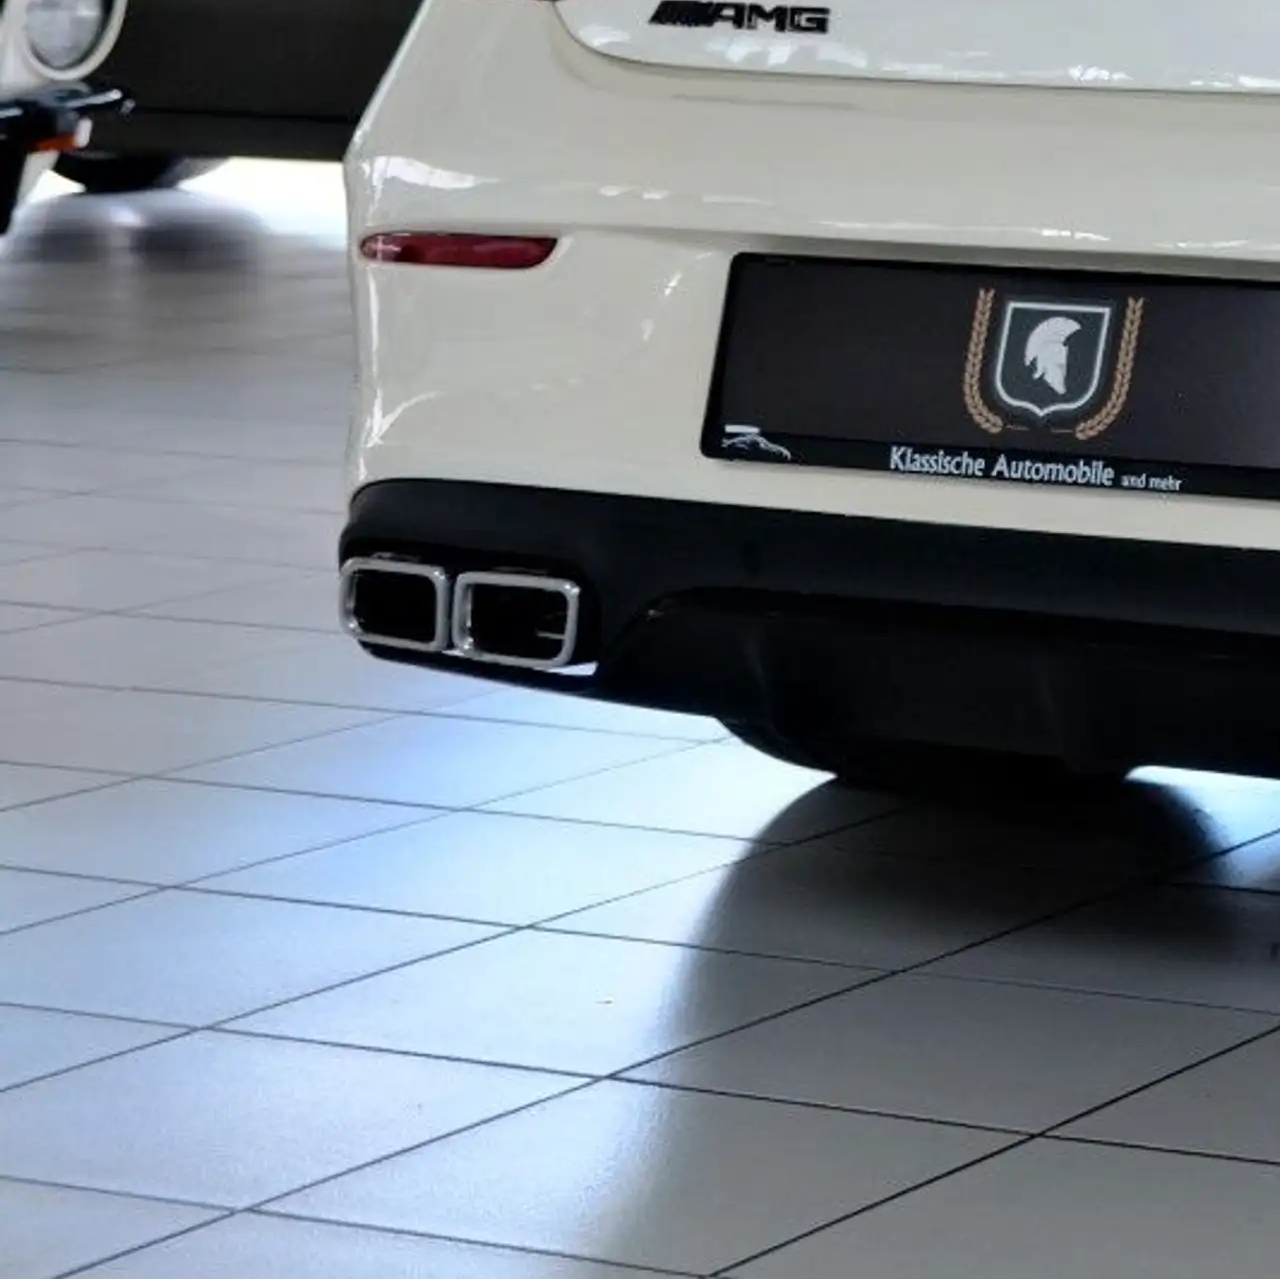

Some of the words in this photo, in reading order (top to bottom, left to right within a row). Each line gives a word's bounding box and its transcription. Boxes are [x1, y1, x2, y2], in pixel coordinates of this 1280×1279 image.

[704, 2, 830, 33] AMG
[889, 445, 985, 476] Klassische
[991, 453, 1115, 486] Automobile
[1120, 475, 1146, 488] und
[1149, 476, 1182, 491] mehr
